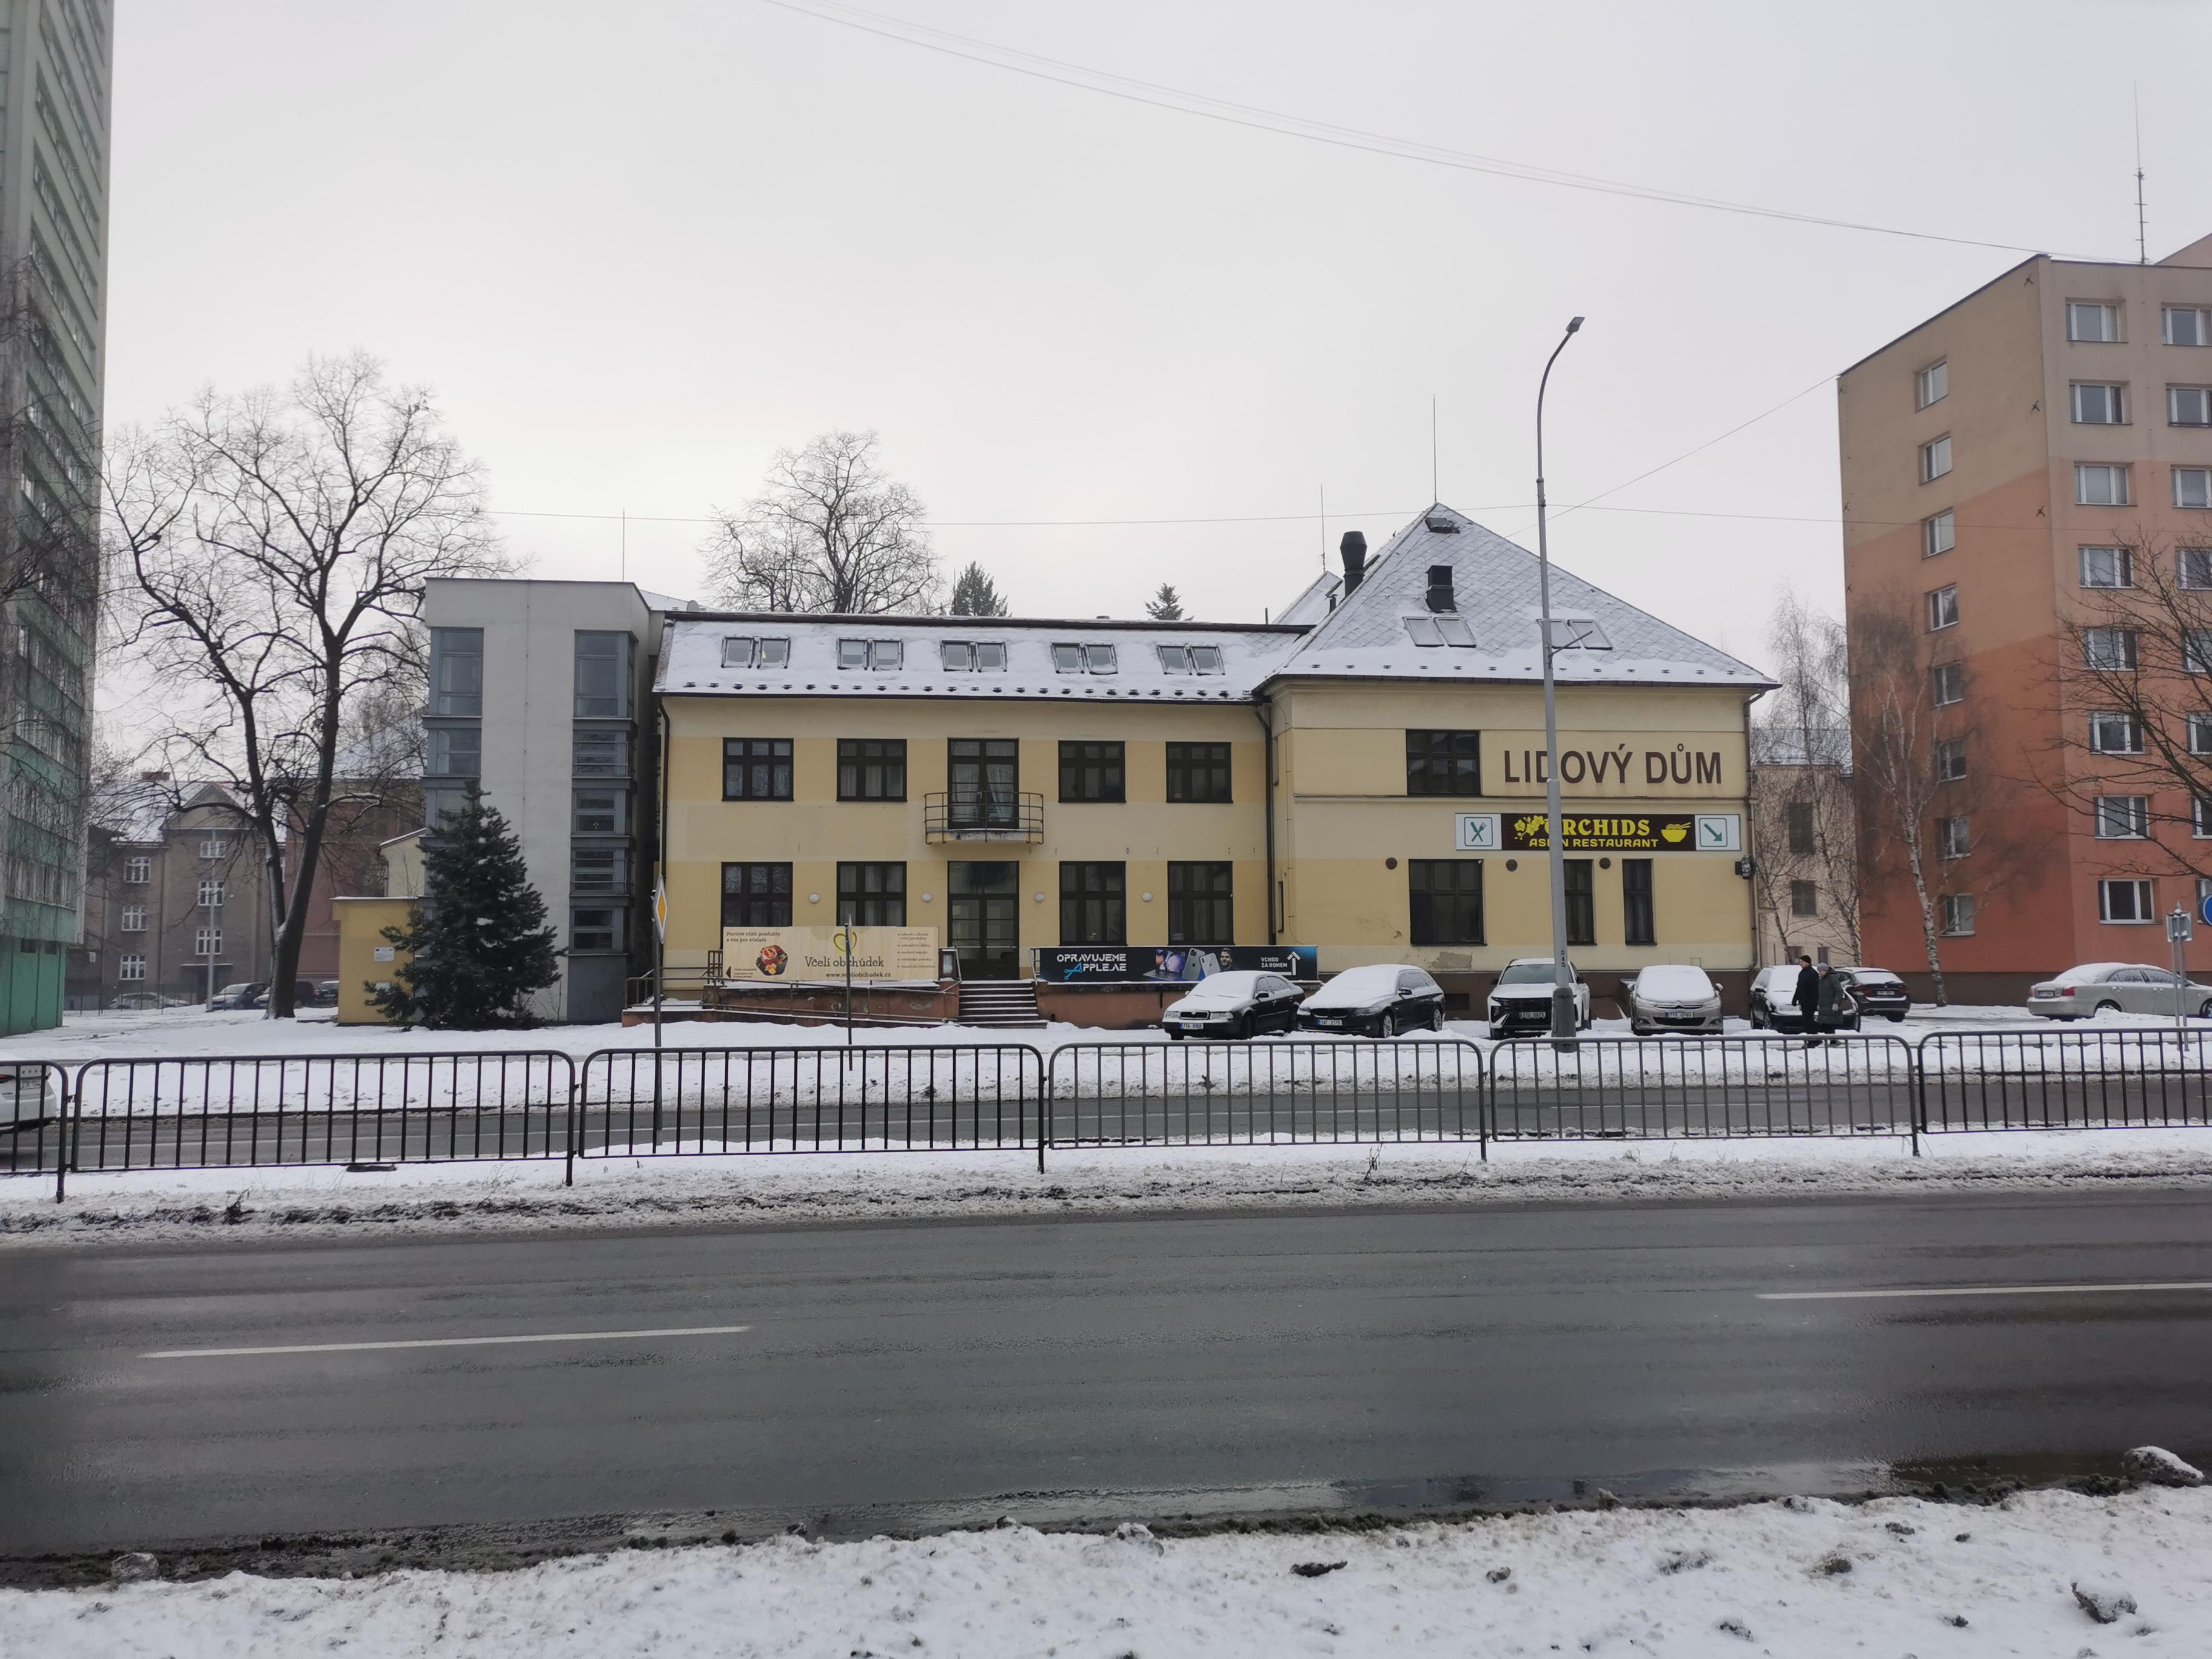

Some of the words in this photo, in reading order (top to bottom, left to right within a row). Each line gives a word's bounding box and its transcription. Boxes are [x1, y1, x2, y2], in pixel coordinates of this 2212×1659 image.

[1645, 743, 1721, 783] DŮM
[1529, 839, 1569, 847] ASIN
[1573, 839, 1658, 848] RESTAURANT
[804, 956, 830, 967] Včelí
[1057, 954, 1127, 962] OPRAVUJEME
